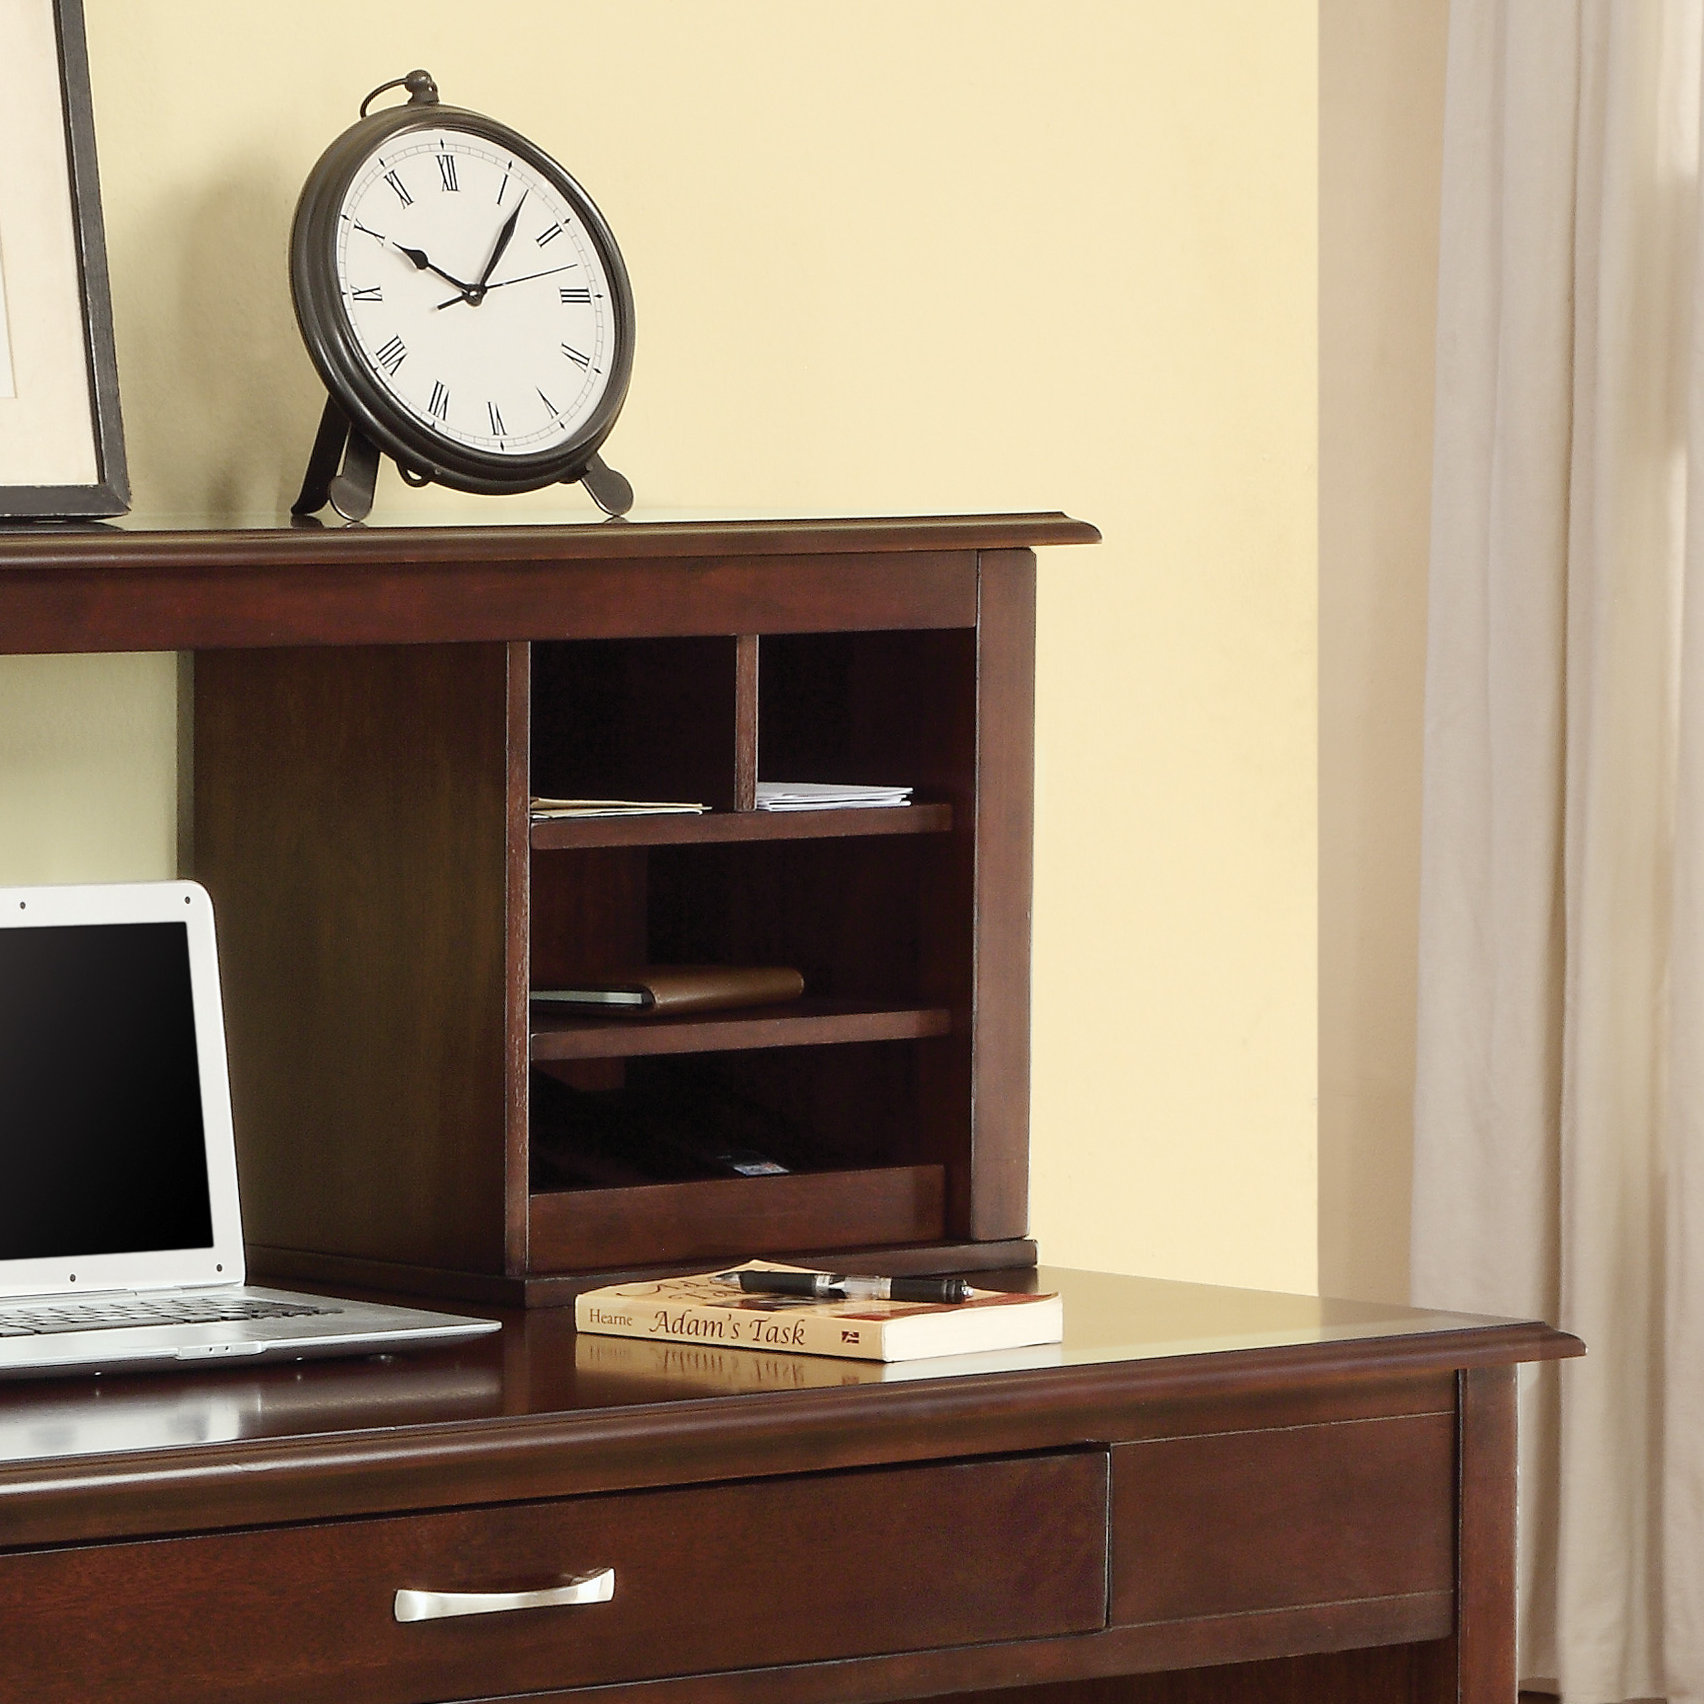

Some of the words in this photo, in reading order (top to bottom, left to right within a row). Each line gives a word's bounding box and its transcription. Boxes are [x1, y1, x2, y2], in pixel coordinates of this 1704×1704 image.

[383, 169, 414, 210] XI
[435, 154, 460, 192] XII
[353, 217, 386, 247] X
[535, 222, 563, 248] II
[349, 283, 384, 302] IX
[559, 286, 592, 304] III
[375, 333, 409, 377] VIII
[561, 342, 591, 373] IV
[428, 380, 450, 421] VII
[535, 386, 560, 420] V
[487, 401, 508, 436] VI
[589, 1307, 633, 1327] Hearne
[648, 1309, 741, 1340] Adam's
[749, 1318, 806, 1346] Task
